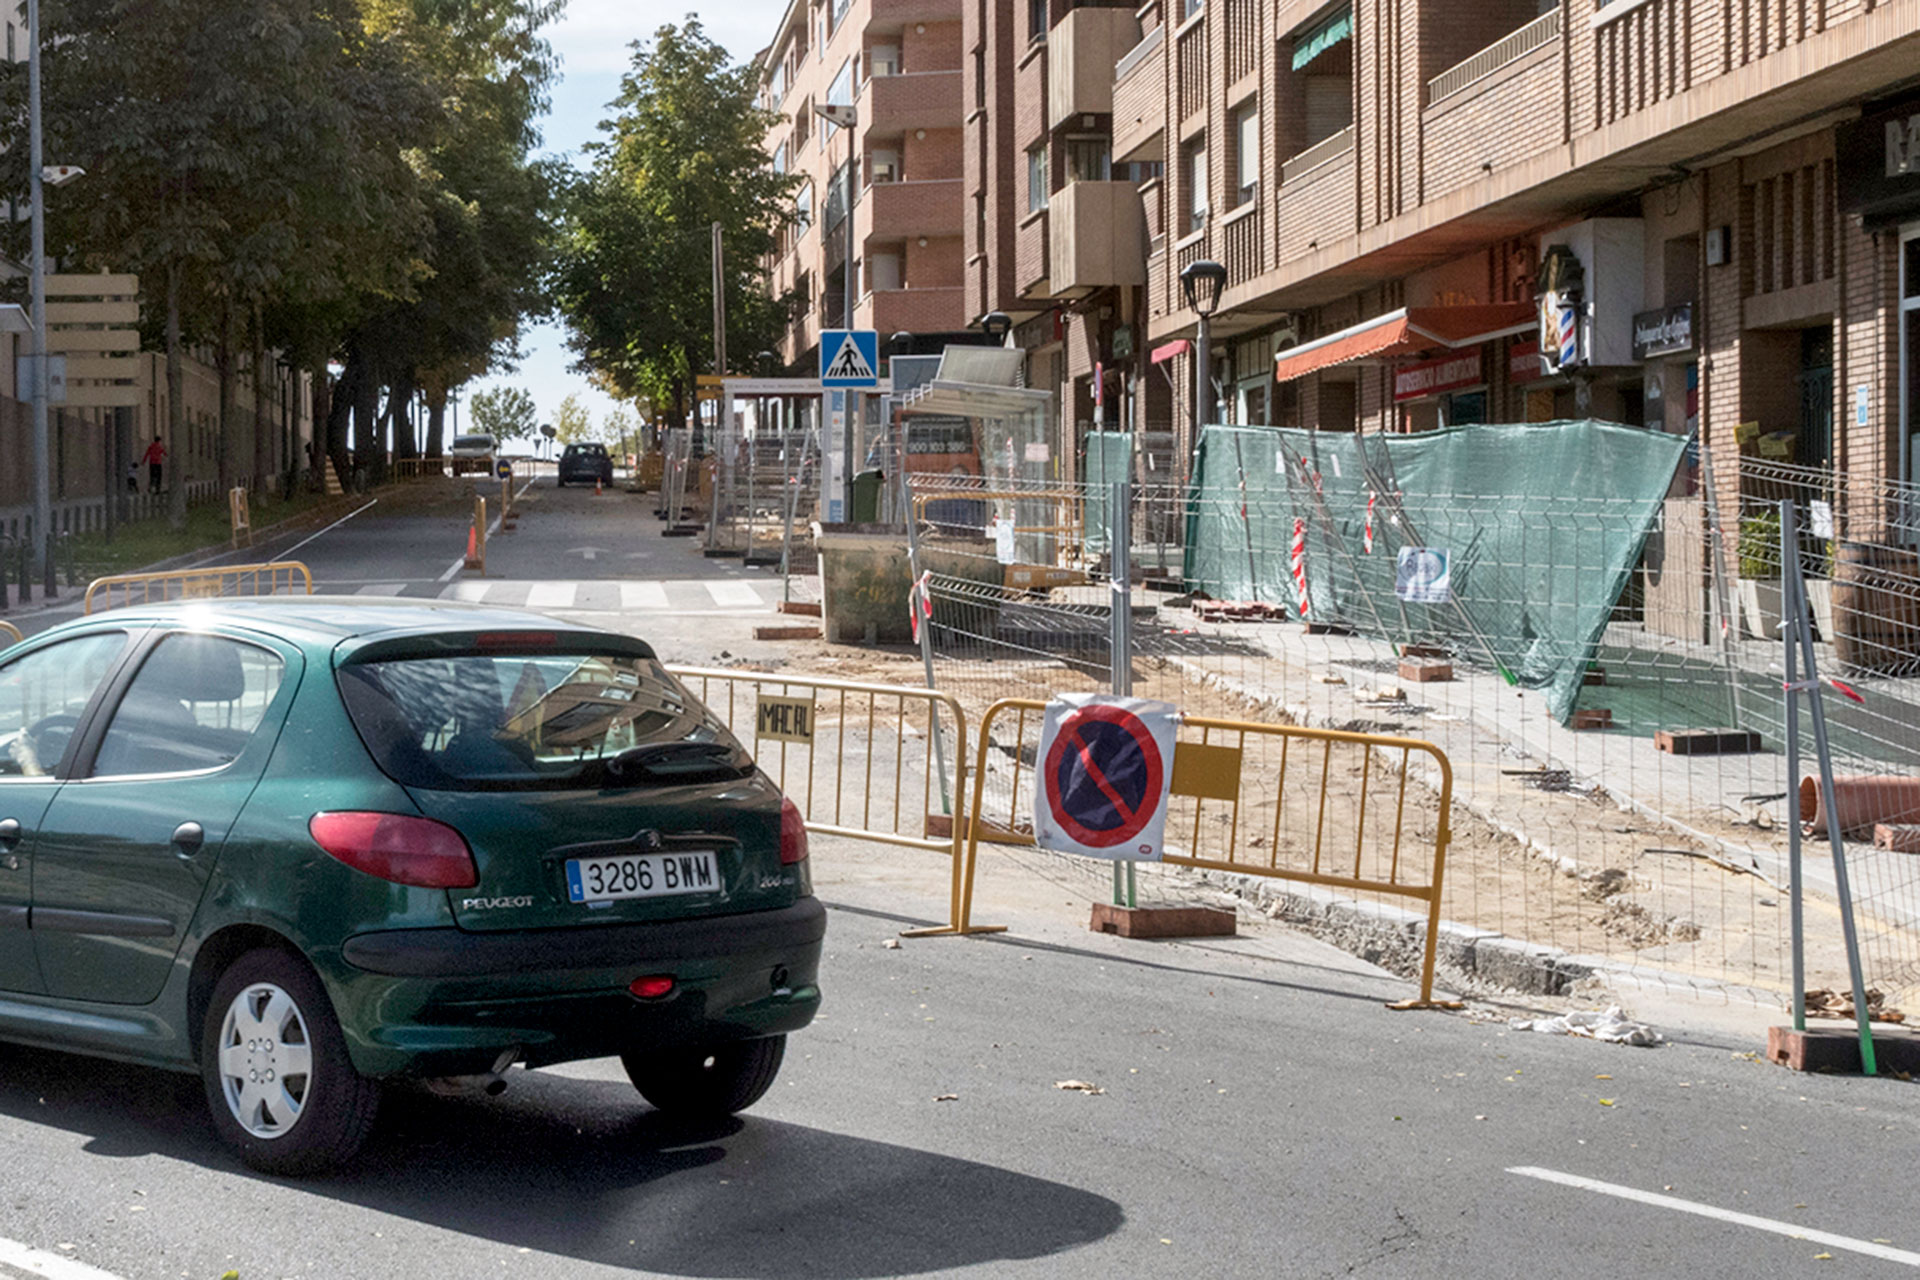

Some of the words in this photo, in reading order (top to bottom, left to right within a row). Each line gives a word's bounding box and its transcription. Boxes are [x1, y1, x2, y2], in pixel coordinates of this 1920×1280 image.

[908, 441, 927, 453] 900
[588, 859, 653, 895] 3286
[666, 855, 713, 889] BWM
[572, 884, 580, 895] E
[462, 895, 534, 910] PEUGEOT
